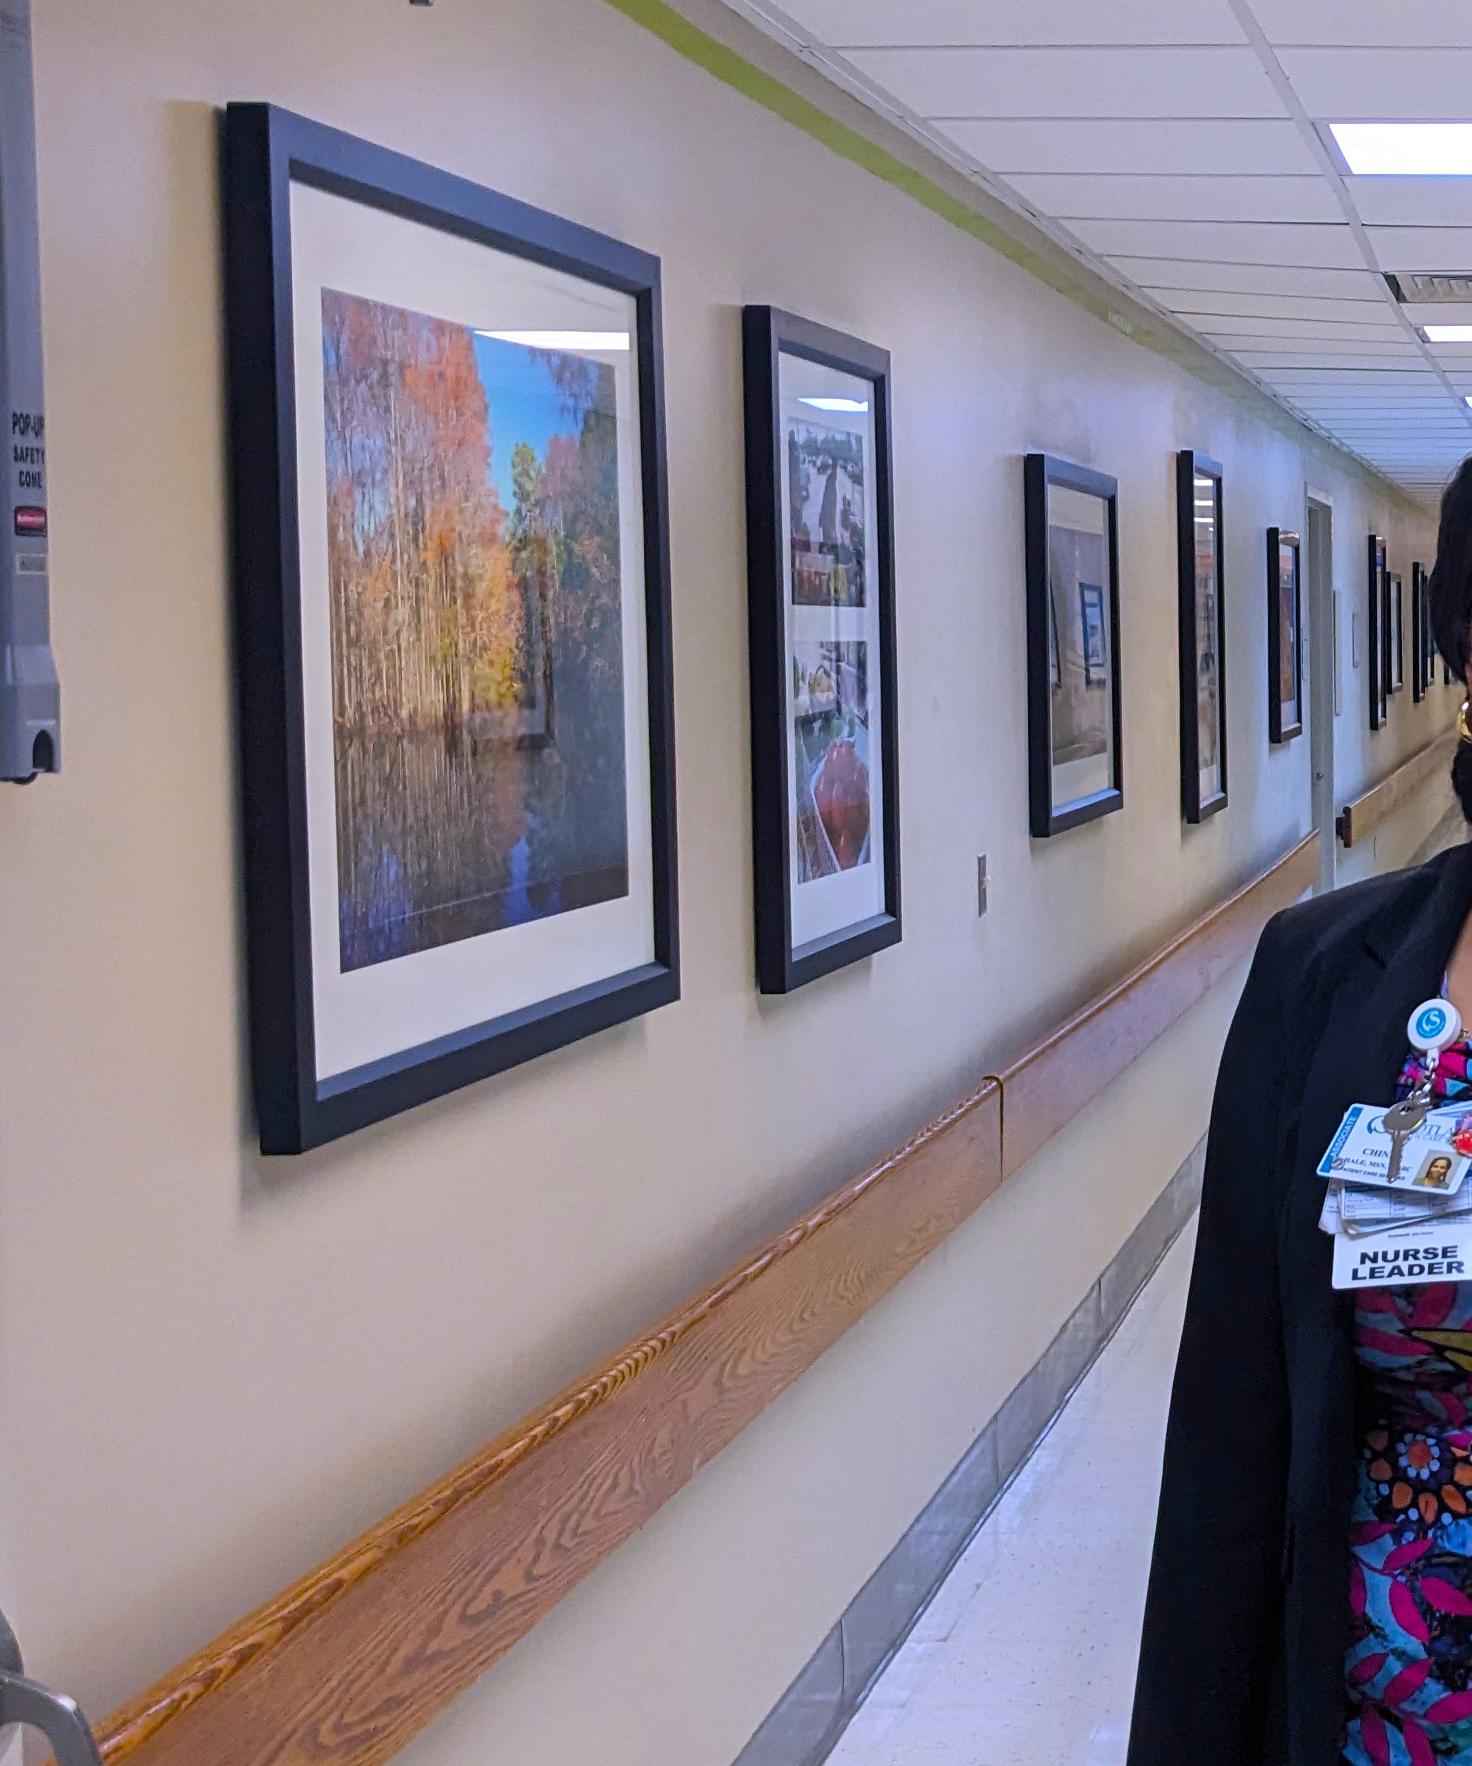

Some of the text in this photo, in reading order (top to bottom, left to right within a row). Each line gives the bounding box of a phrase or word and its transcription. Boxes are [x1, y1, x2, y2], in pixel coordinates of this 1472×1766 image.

[12, 412, 45, 438] POP-UP
[13, 447, 45, 465] SAFETY
[19, 470, 42, 489] CONE
[1330, 1116, 1357, 1158] ASSOCIATE
[1359, 1245, 1458, 1265] NURSE
[1351, 1260, 1465, 1281] LEADER
